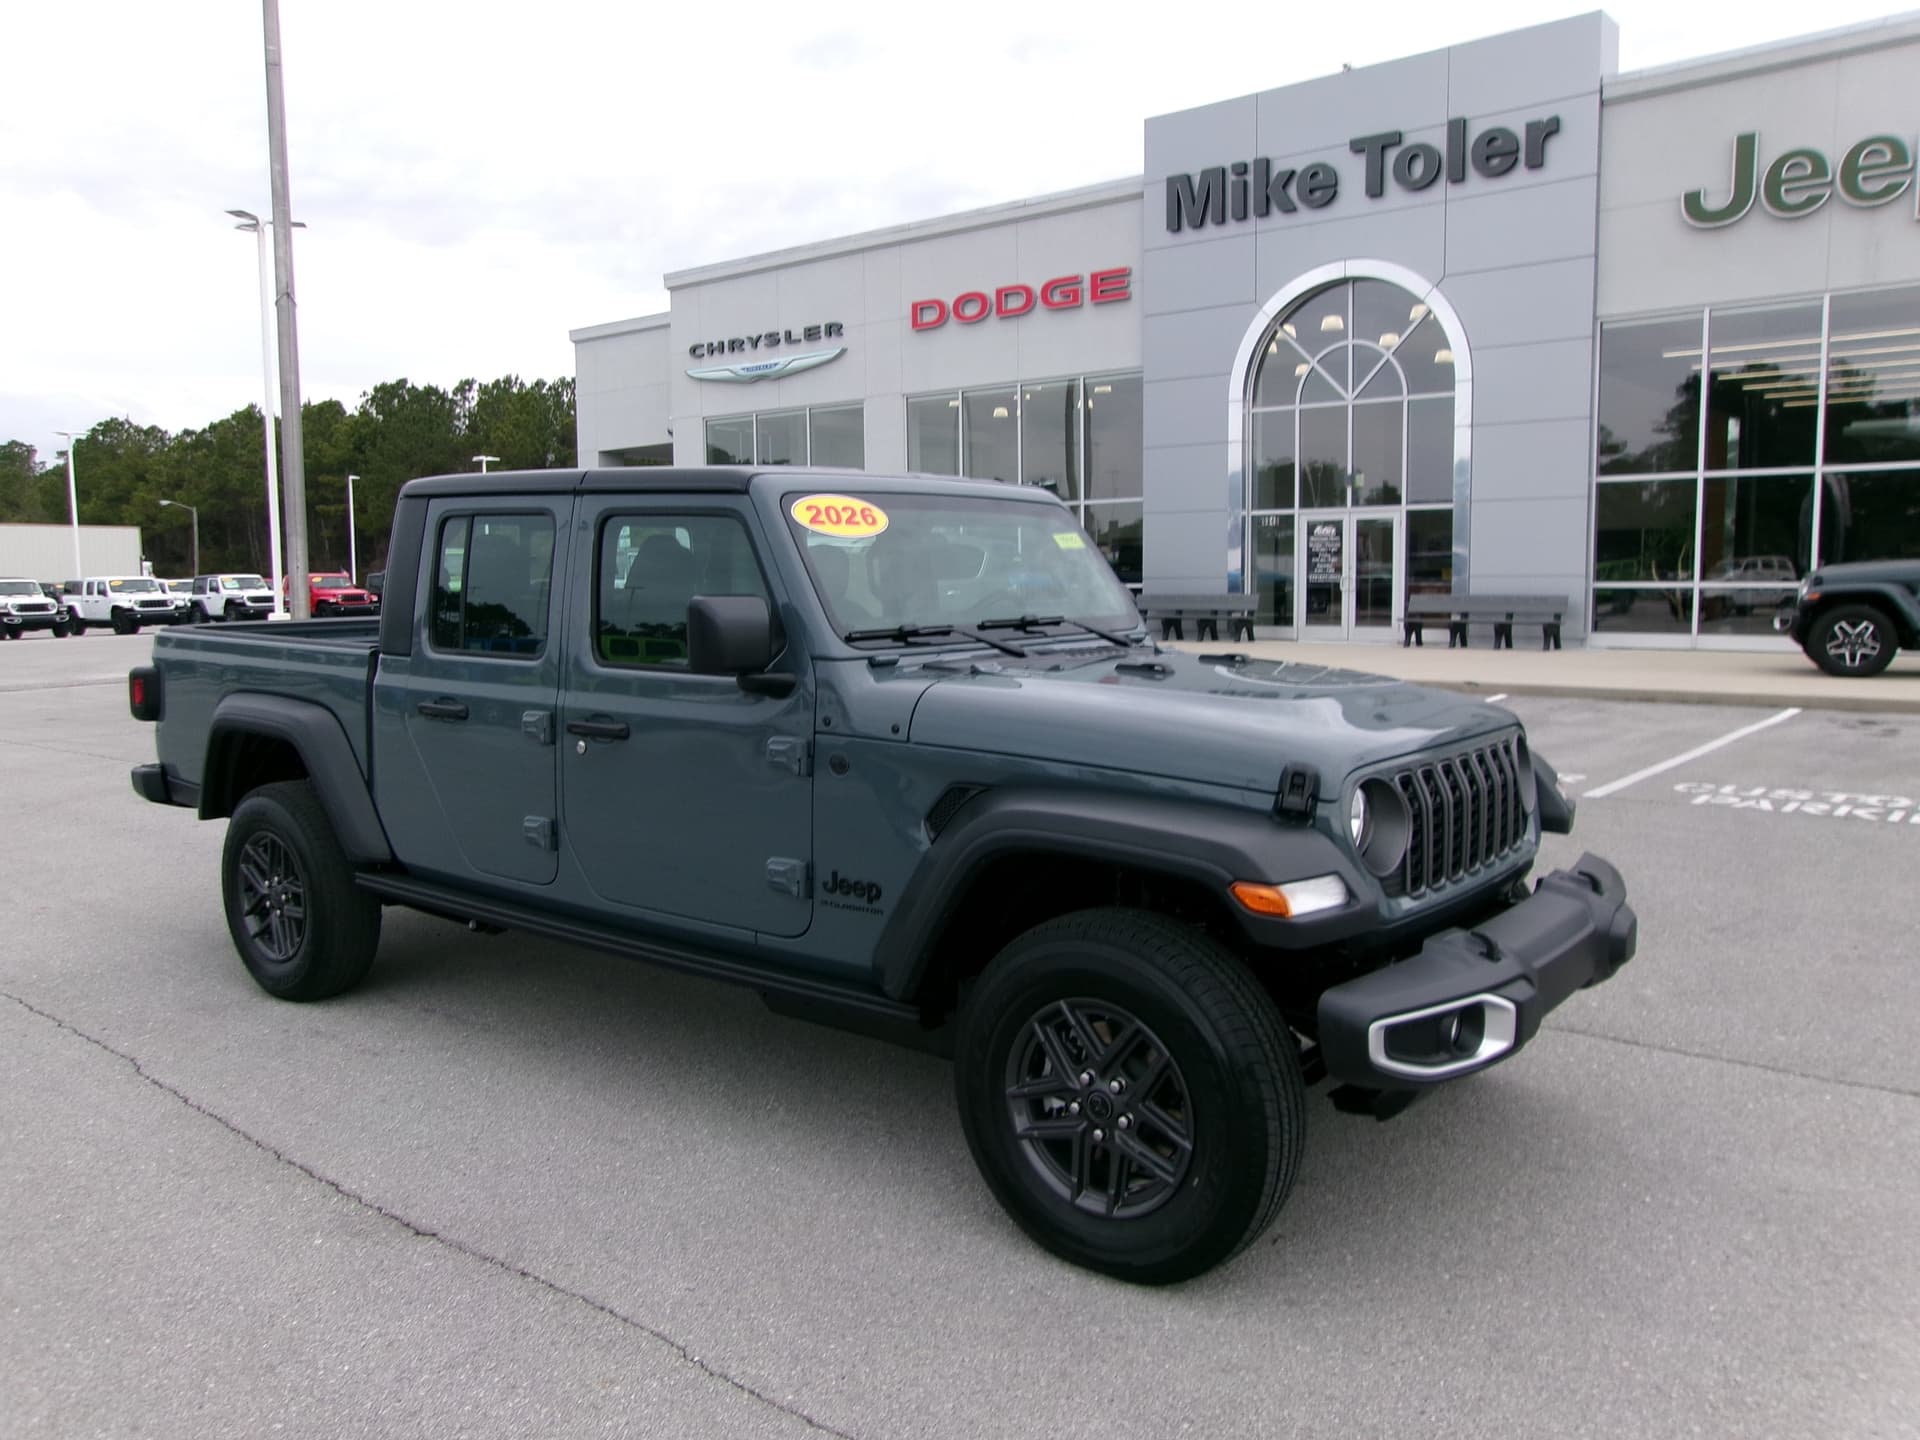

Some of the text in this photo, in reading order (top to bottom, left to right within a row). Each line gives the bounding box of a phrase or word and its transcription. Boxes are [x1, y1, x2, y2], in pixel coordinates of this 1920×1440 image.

[1166, 115, 1560, 233] Mike Toler
[1680, 131, 1920, 230] Jee
[911, 267, 1132, 331] DODGE
[688, 320, 844, 360] CHRYSLER
[805, 504, 878, 527] 2026
[1673, 781, 1920, 809] CUSTO
[821, 869, 882, 904] Jeep
